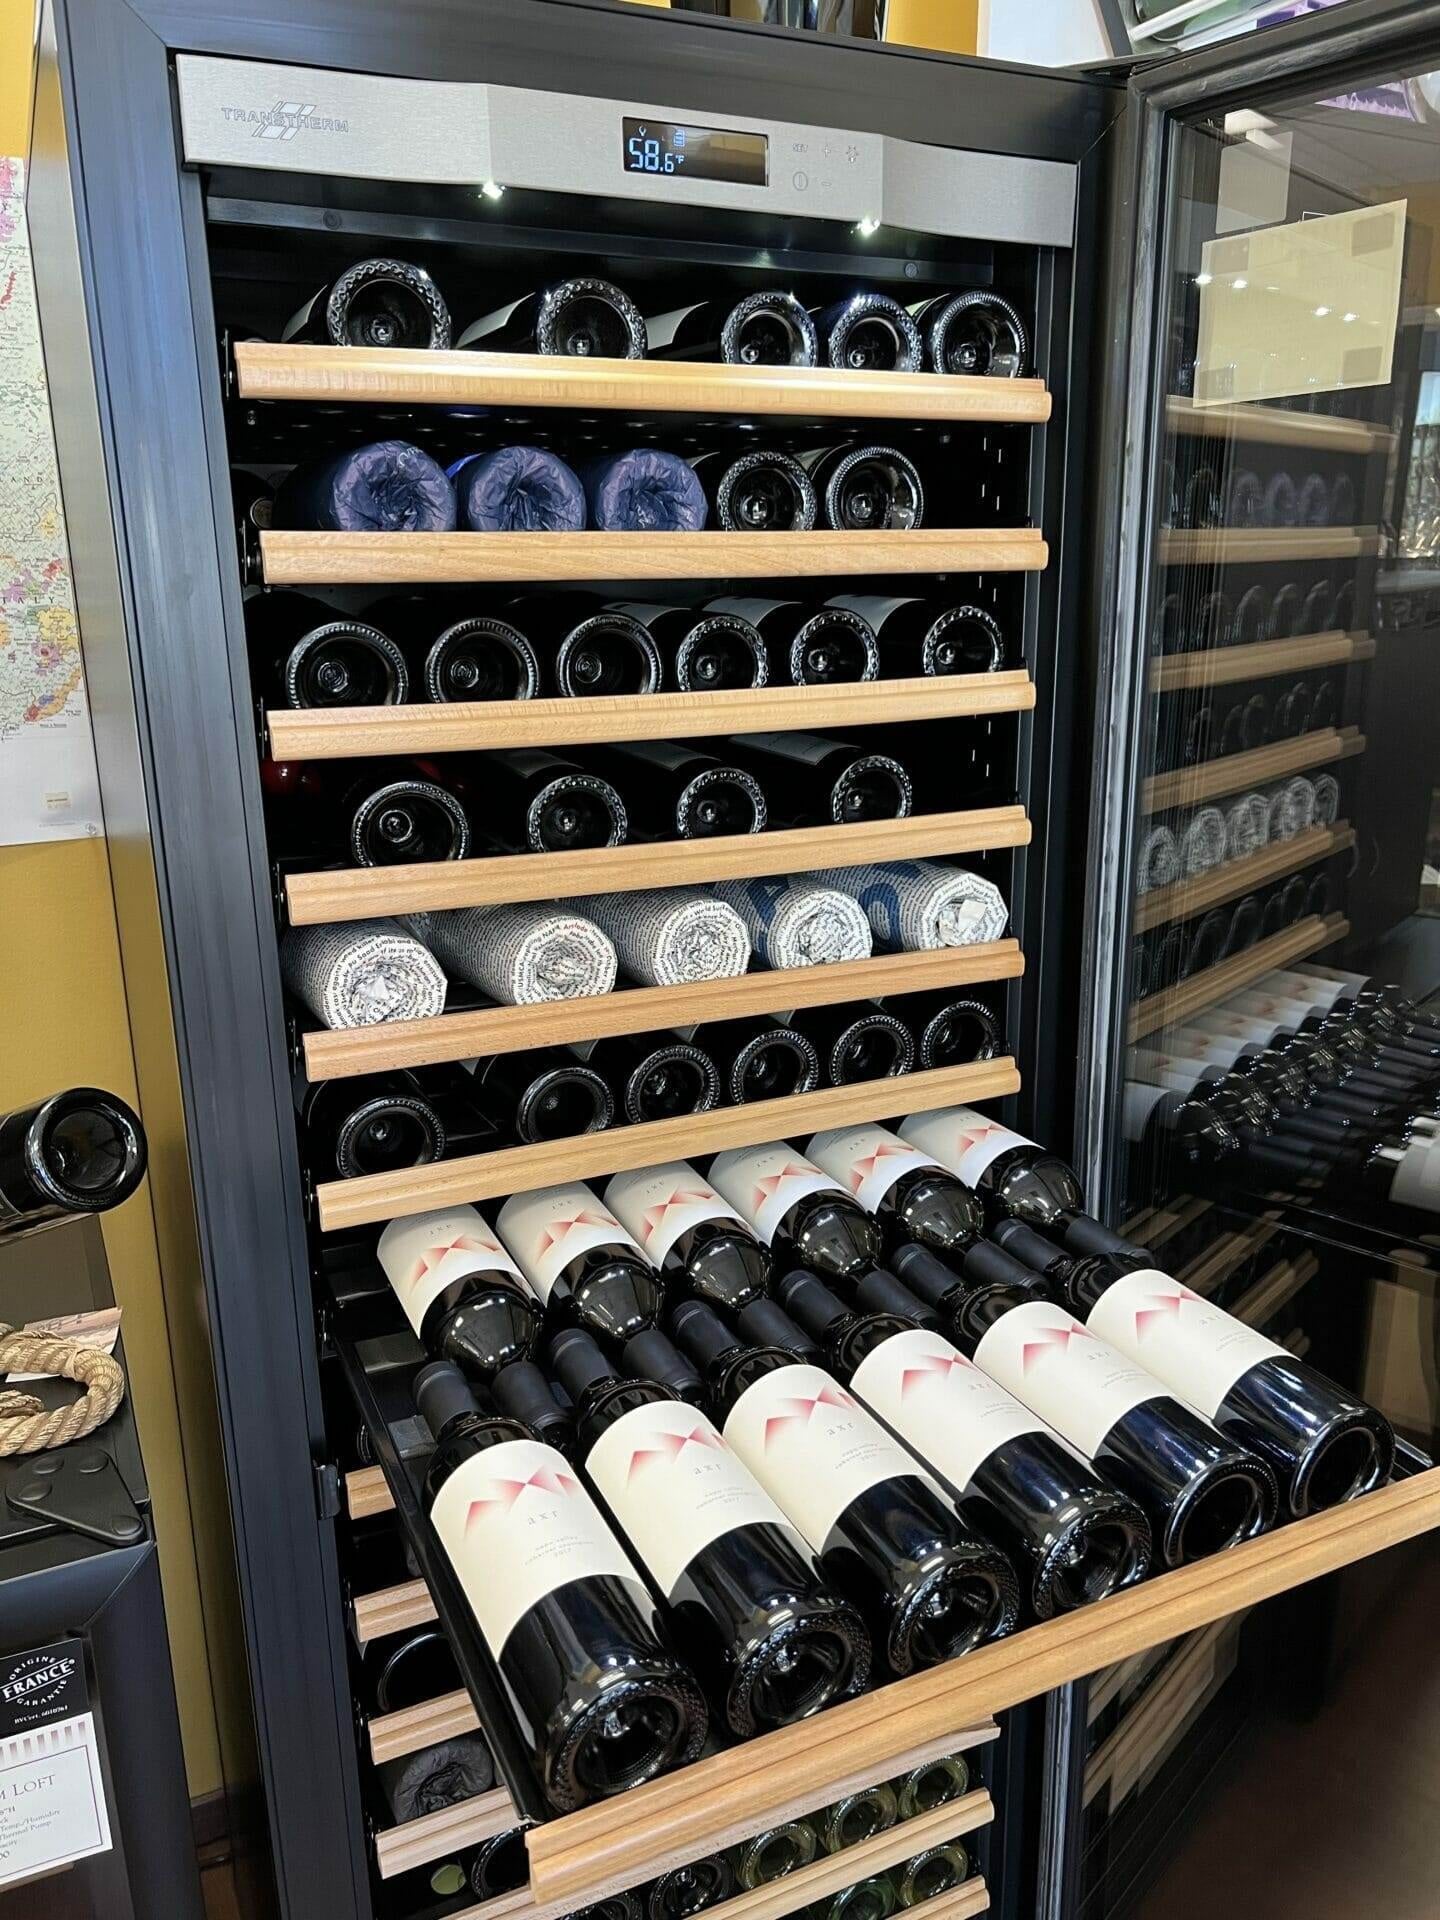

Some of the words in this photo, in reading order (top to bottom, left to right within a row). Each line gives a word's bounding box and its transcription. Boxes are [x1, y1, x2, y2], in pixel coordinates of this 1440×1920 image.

[221, 107, 349, 133] TRANSTHERM
[9, 1656, 57, 1681] ORIGINE
[16, 1680, 68, 1706] GARANTIE
[13, 1774, 56, 1797] LOFT
